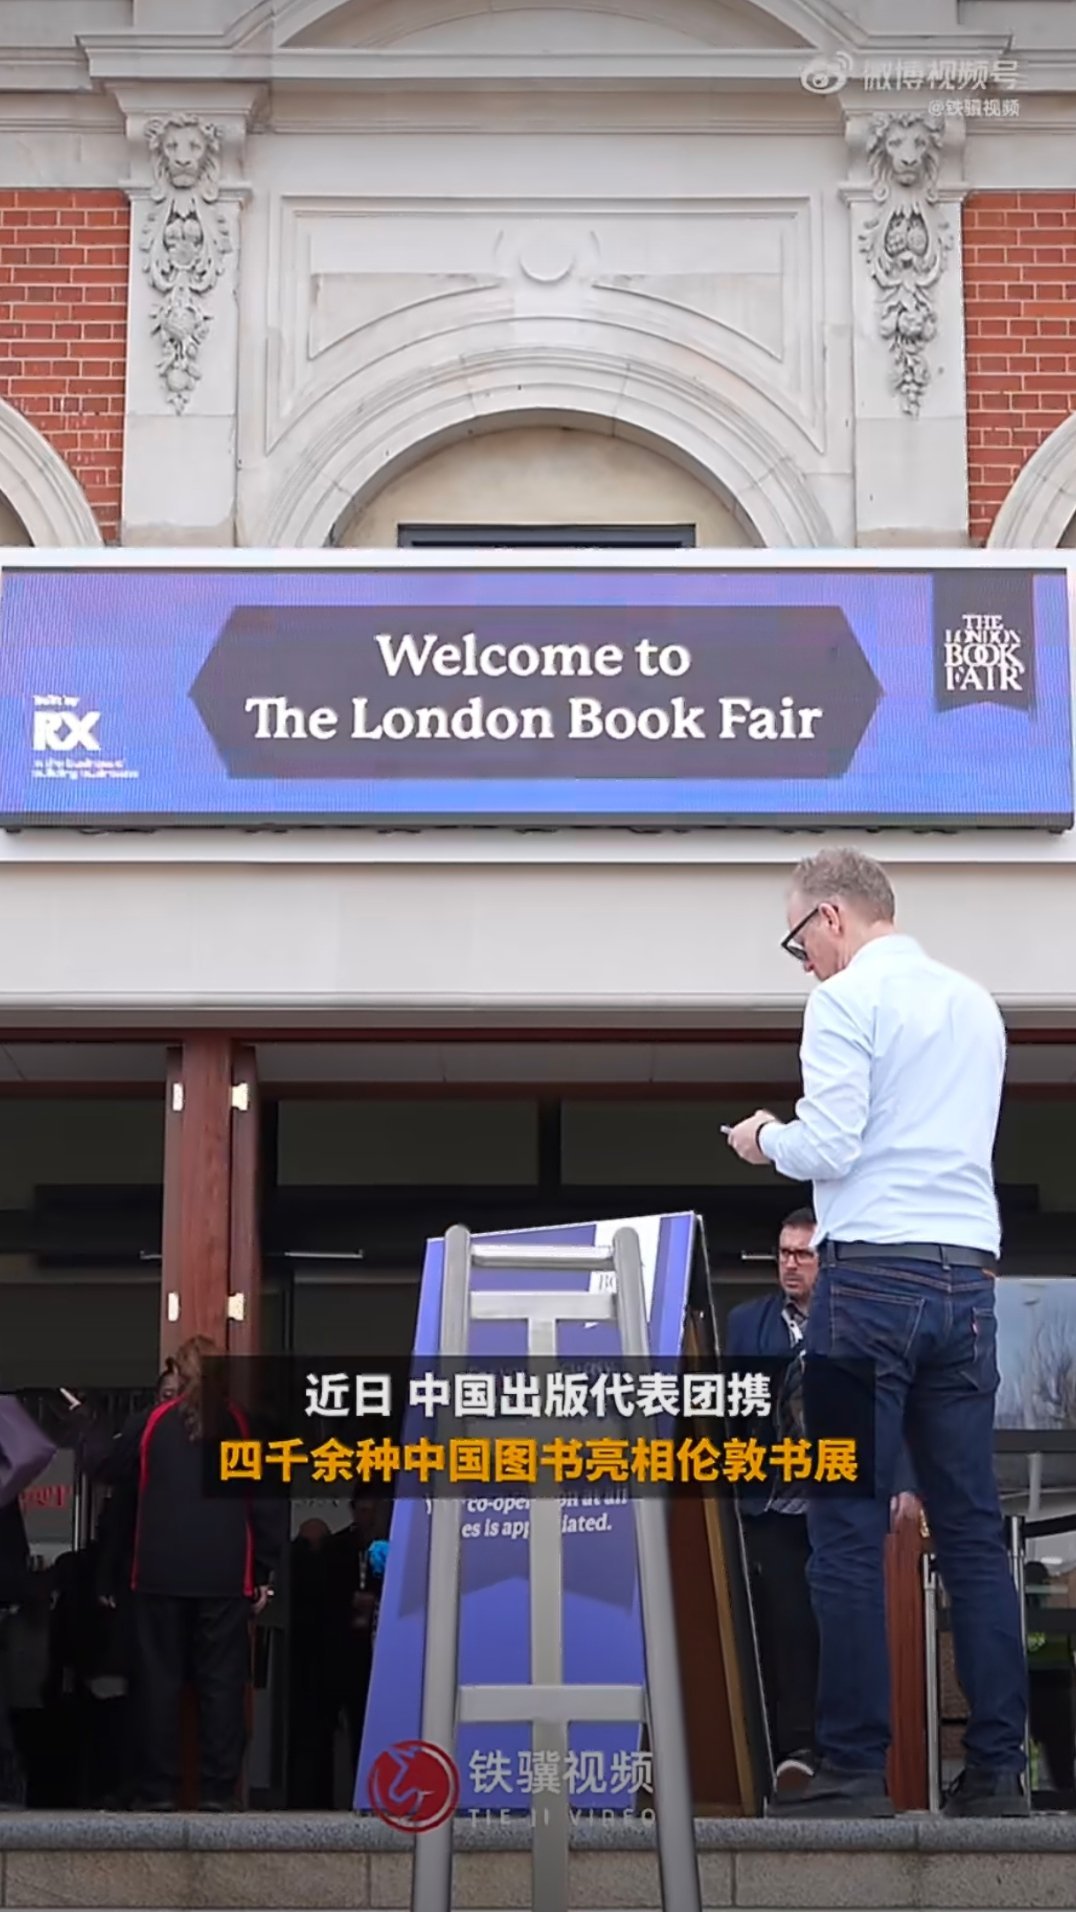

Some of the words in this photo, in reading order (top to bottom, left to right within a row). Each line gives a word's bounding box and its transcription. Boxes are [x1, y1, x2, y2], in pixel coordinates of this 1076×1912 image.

[961, 613, 1004, 630] THE
[374, 633, 624, 677] Welcome
[635, 638, 693, 677] to
[944, 643, 1024, 674] BOOK
[945, 666, 1023, 691] FAIR
[33, 711, 101, 751] RX
[245, 697, 338, 740] The
[351, 697, 555, 740] London
[568, 697, 706, 740] Book
[719, 696, 823, 740] Fair
[483, 1518, 500, 1537] is
